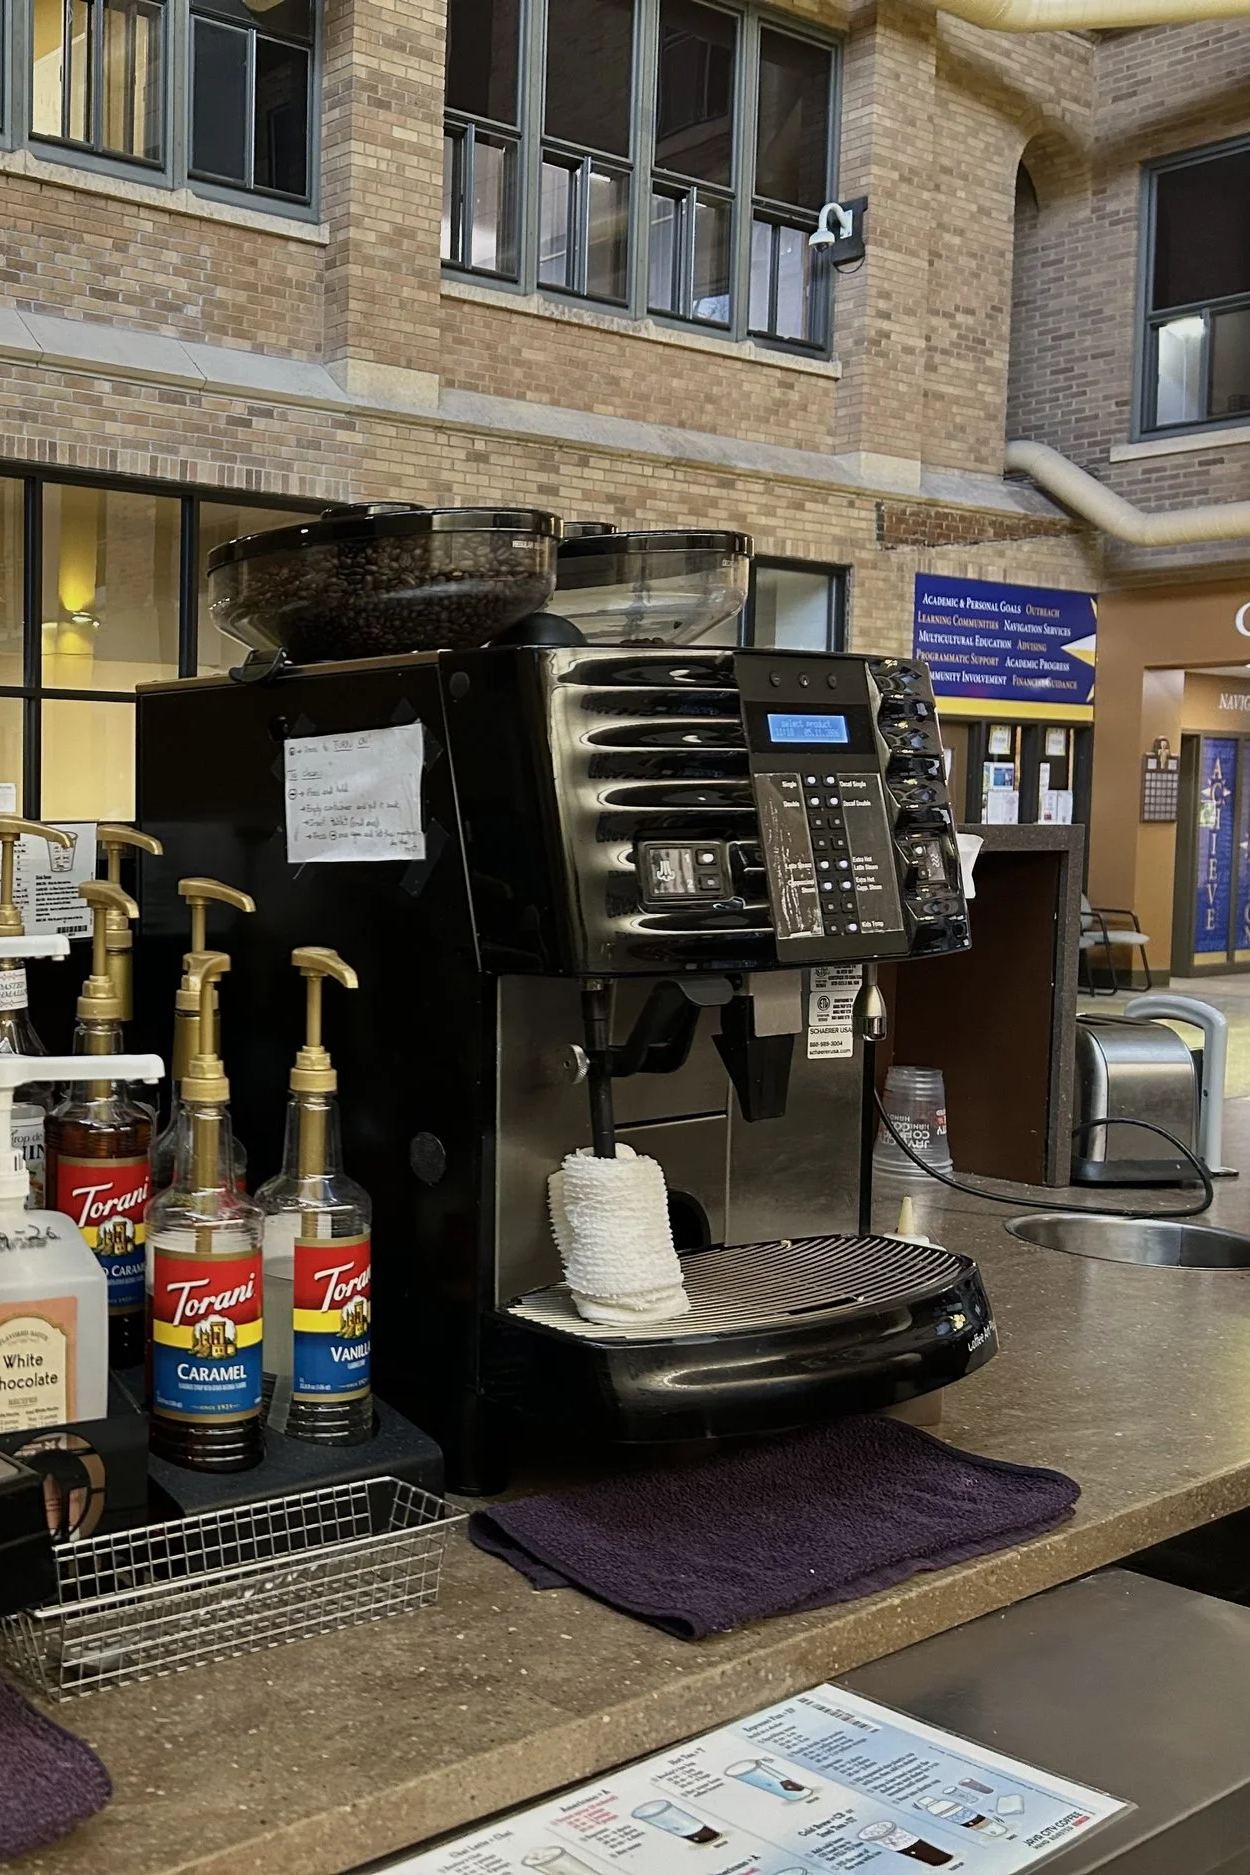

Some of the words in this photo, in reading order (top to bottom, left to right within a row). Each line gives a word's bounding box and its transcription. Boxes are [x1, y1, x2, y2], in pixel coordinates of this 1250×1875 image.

[929, 671, 961, 682] MMUNITY
[686, 879, 695, 888] 2
[72, 1176, 149, 1228] Torani
[111, 1264, 147, 1278] CARAM
[314, 1261, 371, 1313] Tora
[166, 1272, 256, 1327] Torani
[3, 1353, 44, 1370] White
[177, 1363, 247, 1382] CARAMEL
